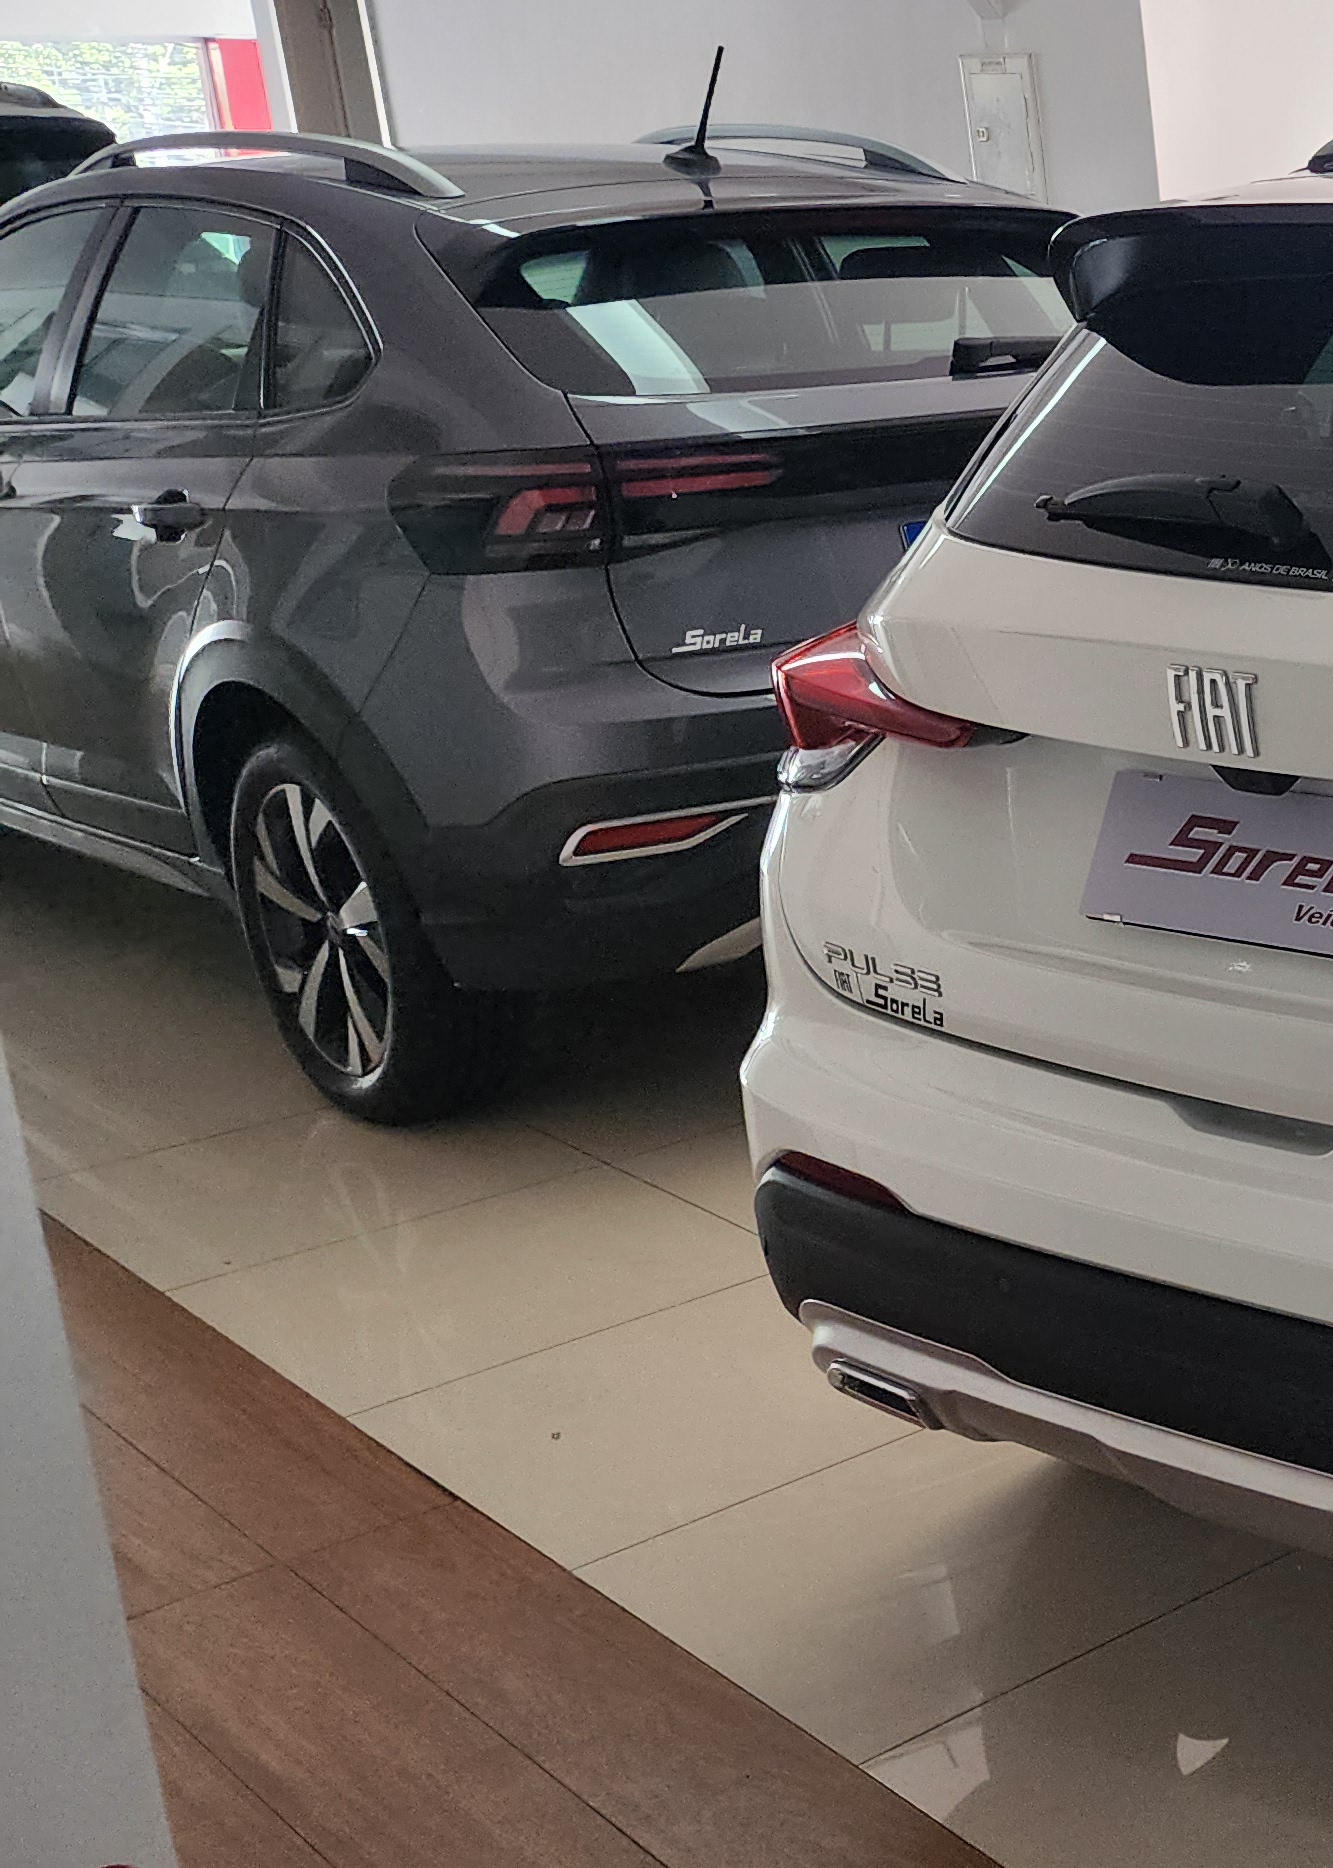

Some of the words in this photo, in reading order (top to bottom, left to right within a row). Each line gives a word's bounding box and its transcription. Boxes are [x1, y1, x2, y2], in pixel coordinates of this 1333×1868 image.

[1272, 565, 1290, 574] DE
[1289, 566, 1328, 580] BRASIL
[1166, 663, 1260, 758] FIAT
[823, 941, 943, 998] PULSE
[833, 969, 853, 994] FIAT
